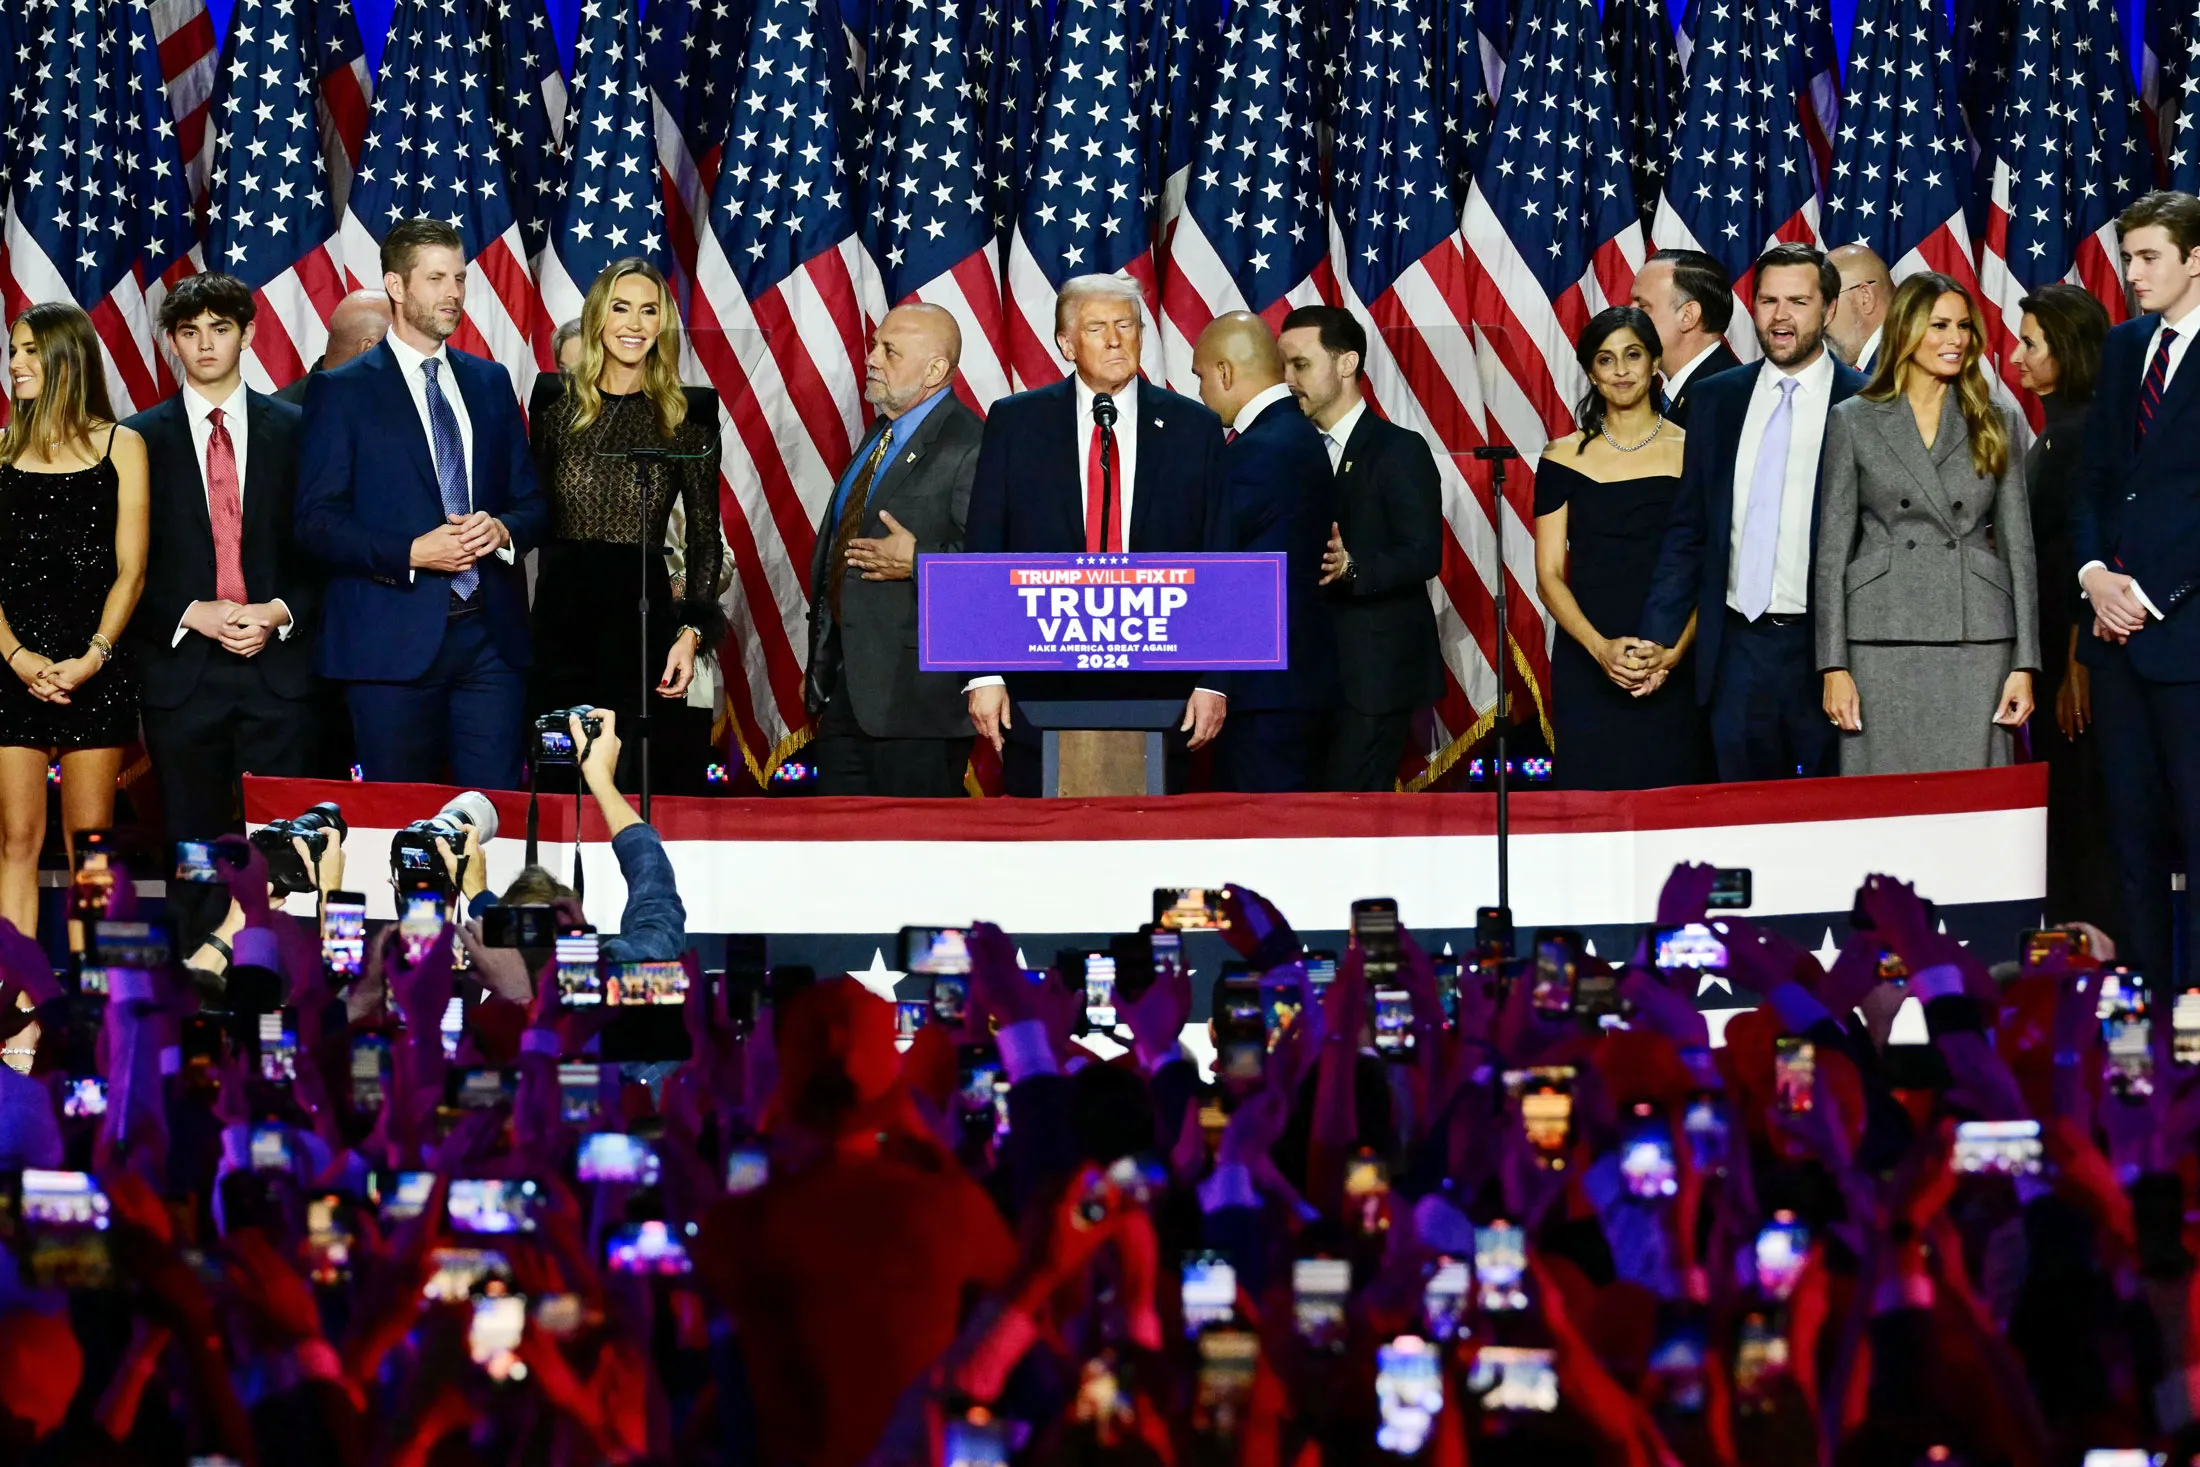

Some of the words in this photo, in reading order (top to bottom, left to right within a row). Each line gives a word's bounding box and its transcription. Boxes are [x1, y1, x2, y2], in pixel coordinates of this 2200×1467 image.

[1018, 570, 1082, 584] TRUMP
[1086, 569, 1131, 584] WILL
[1135, 569, 1166, 584] FIX
[1169, 569, 1188, 584] IT
[1017, 587, 1189, 617] TRUMP
[1037, 617, 1168, 642] VANCE
[1028, 644, 1057, 652] MAKE
[1059, 644, 1105, 652] AMERICA
[1106, 644, 1140, 652] GREAT
[1141, 644, 1178, 652] AGAIN!
[1076, 654, 1130, 669] 2024
